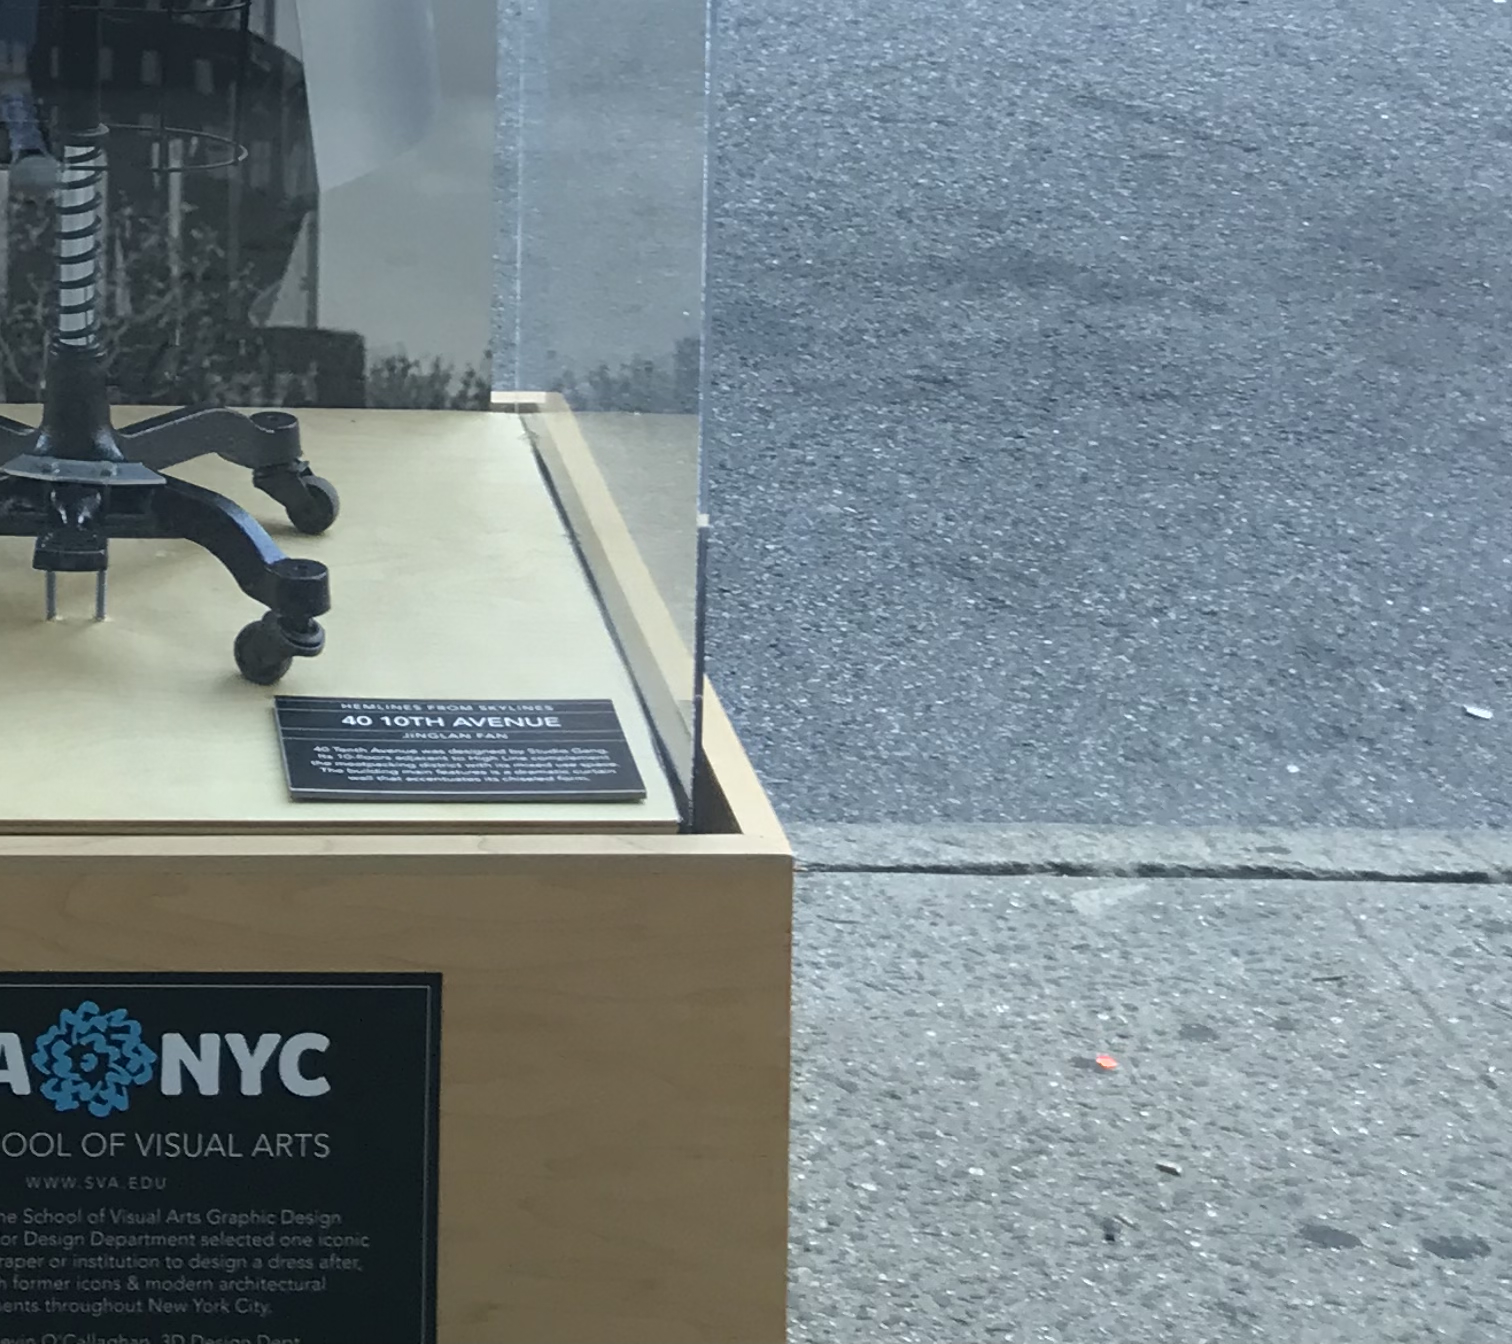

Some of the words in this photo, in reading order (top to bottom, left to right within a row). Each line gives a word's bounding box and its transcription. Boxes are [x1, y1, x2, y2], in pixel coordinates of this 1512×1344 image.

[341, 715, 373, 726] 40
[380, 715, 445, 727] 10TH
[452, 716, 562, 727] AVENUE
[161, 1032, 331, 1097] NYC
[80, 1132, 126, 1157] OF
[134, 1132, 243, 1157] VISUAL
[250, 1133, 330, 1158] ARTS
[25, 1175, 166, 1189] WWW.SVA.EDU
[22, 1207, 82, 1224] School
[86, 1207, 106, 1224] of
[108, 1208, 161, 1224] Visual
[164, 1209, 202, 1224] Arts
[205, 1208, 276, 1227] Graphic
[280, 1208, 341, 1228] Design
[23, 1230, 85, 1250] Design
[89, 1230, 196, 1249] Department
[200, 1231, 275, 1247] selected
[278, 1235, 313, 1247] one
[318, 1231, 370, 1247] iconic
[48, 1257, 70, 1269] or
[72, 1254, 160, 1269] institution
[164, 1256, 184, 1269] to
[187, 1253, 247, 1272] design
[251, 1257, 263, 1268] a
[267, 1253, 314, 1269] dress
[12, 1274, 71, 1290] former
[76, 1279, 122, 1291] icons
[126, 1274, 140, 1290] &
[144, 1275, 214, 1291] modern
[218, 1275, 326, 1292] architectural
[44, 1297, 143, 1316] throughout
[147, 1297, 188, 1313] New
[191, 1297, 230, 1313] York
